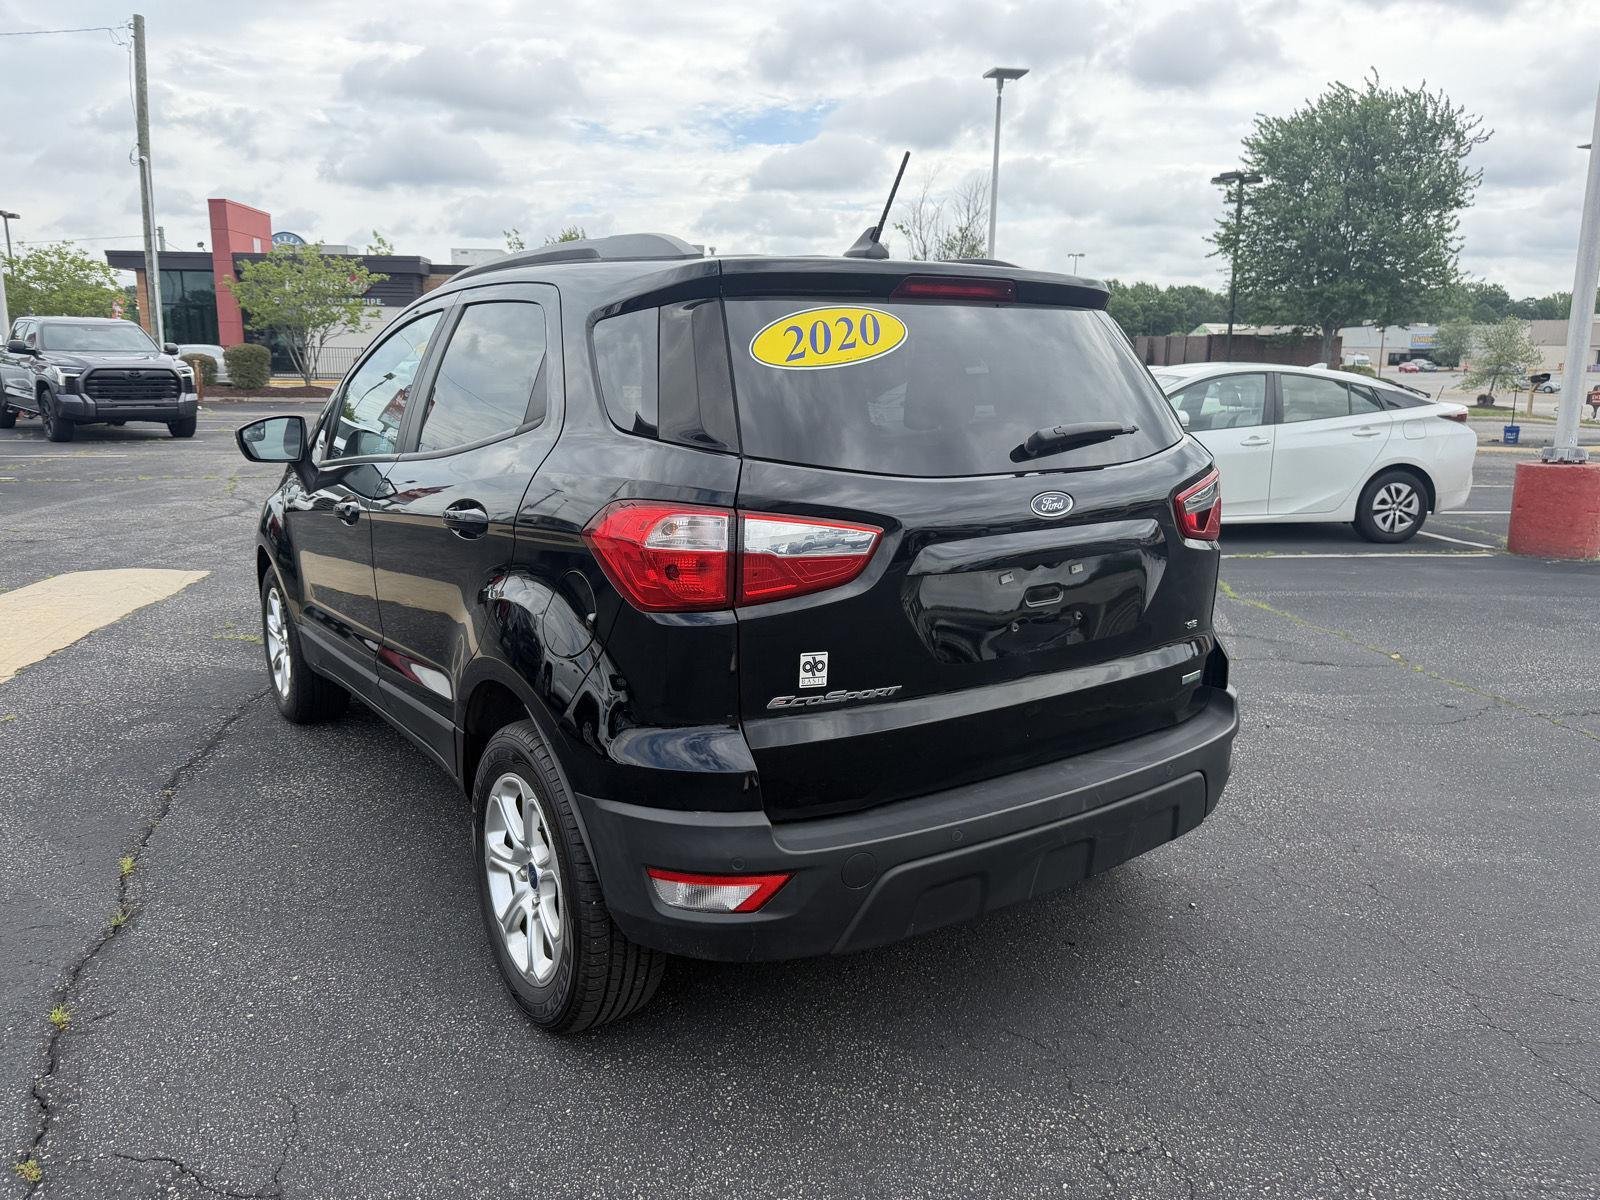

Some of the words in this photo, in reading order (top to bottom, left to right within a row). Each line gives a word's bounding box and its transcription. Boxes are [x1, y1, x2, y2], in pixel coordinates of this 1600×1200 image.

[783, 313, 881, 362] 2020
[1041, 497, 1064, 511] Ford
[801, 677, 826, 685] BASIL
